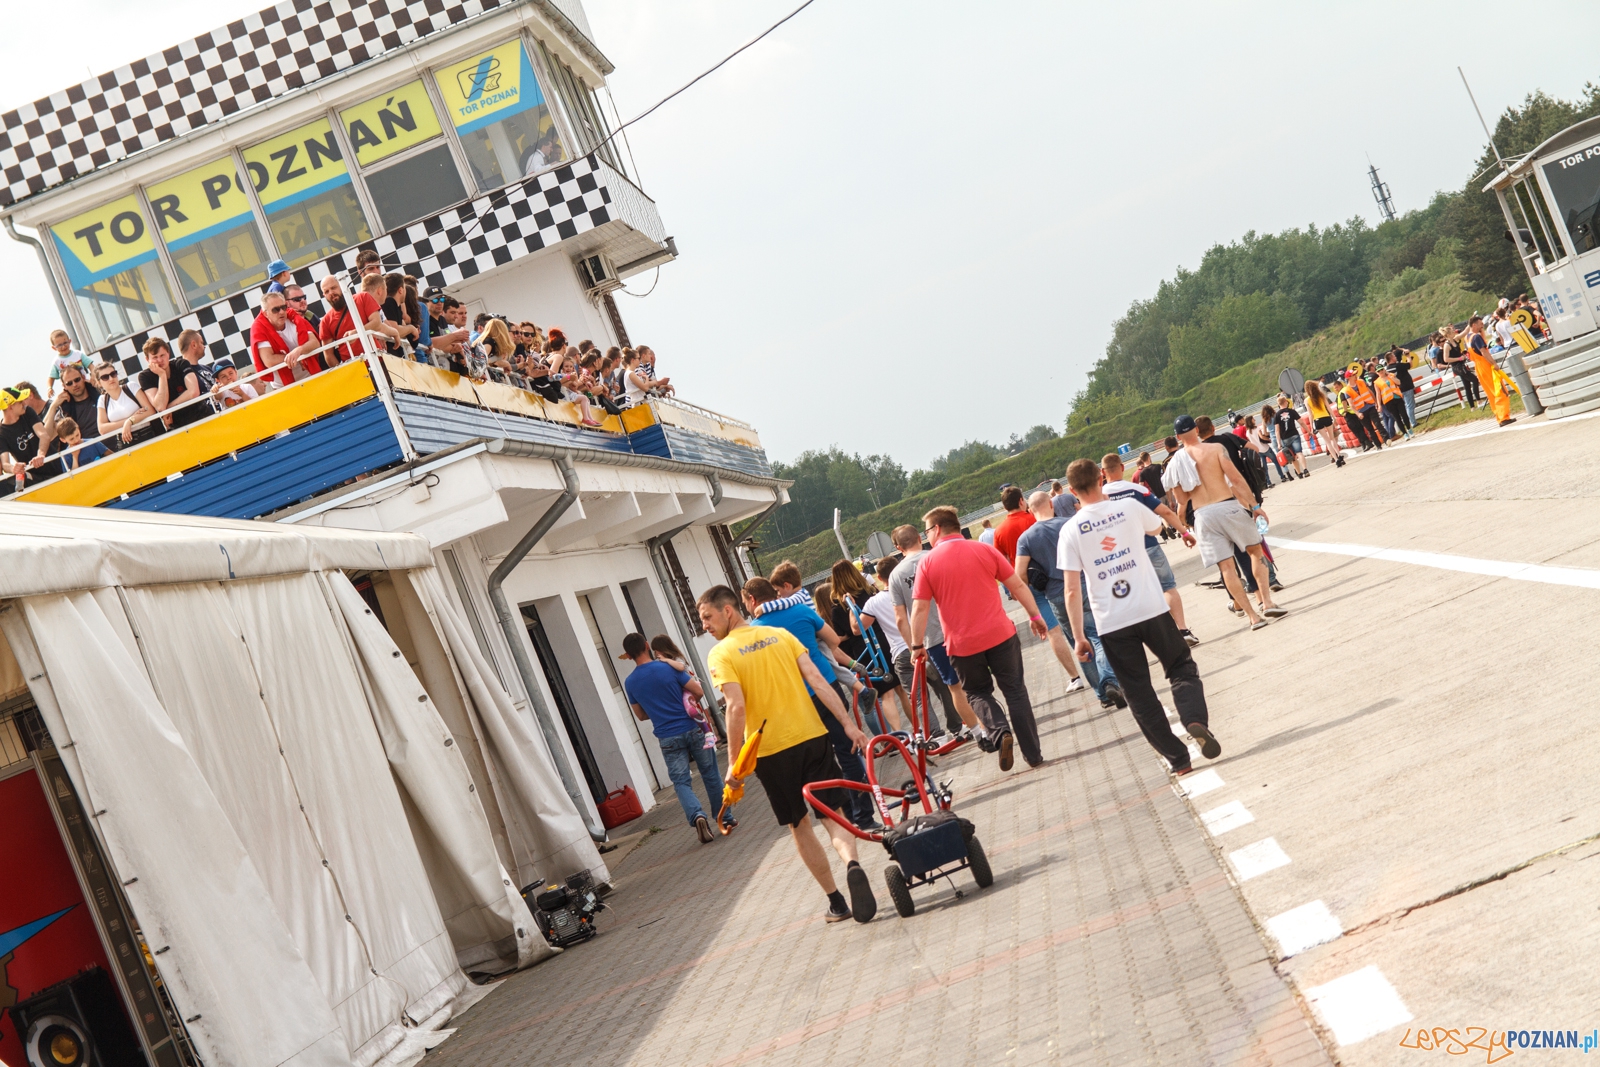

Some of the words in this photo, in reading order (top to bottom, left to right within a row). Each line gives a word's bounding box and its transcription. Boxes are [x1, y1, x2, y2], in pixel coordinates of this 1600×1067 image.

[459, 103, 479, 116] TOR
[480, 86, 518, 108] POZNAŃ
[1559, 153, 1585, 169] TOR
[75, 194, 189, 257] TOR
[201, 96, 417, 210] POZNAŃ
[1094, 547, 1131, 566] SUZUKI
[1107, 559, 1137, 577] YAMAHA
